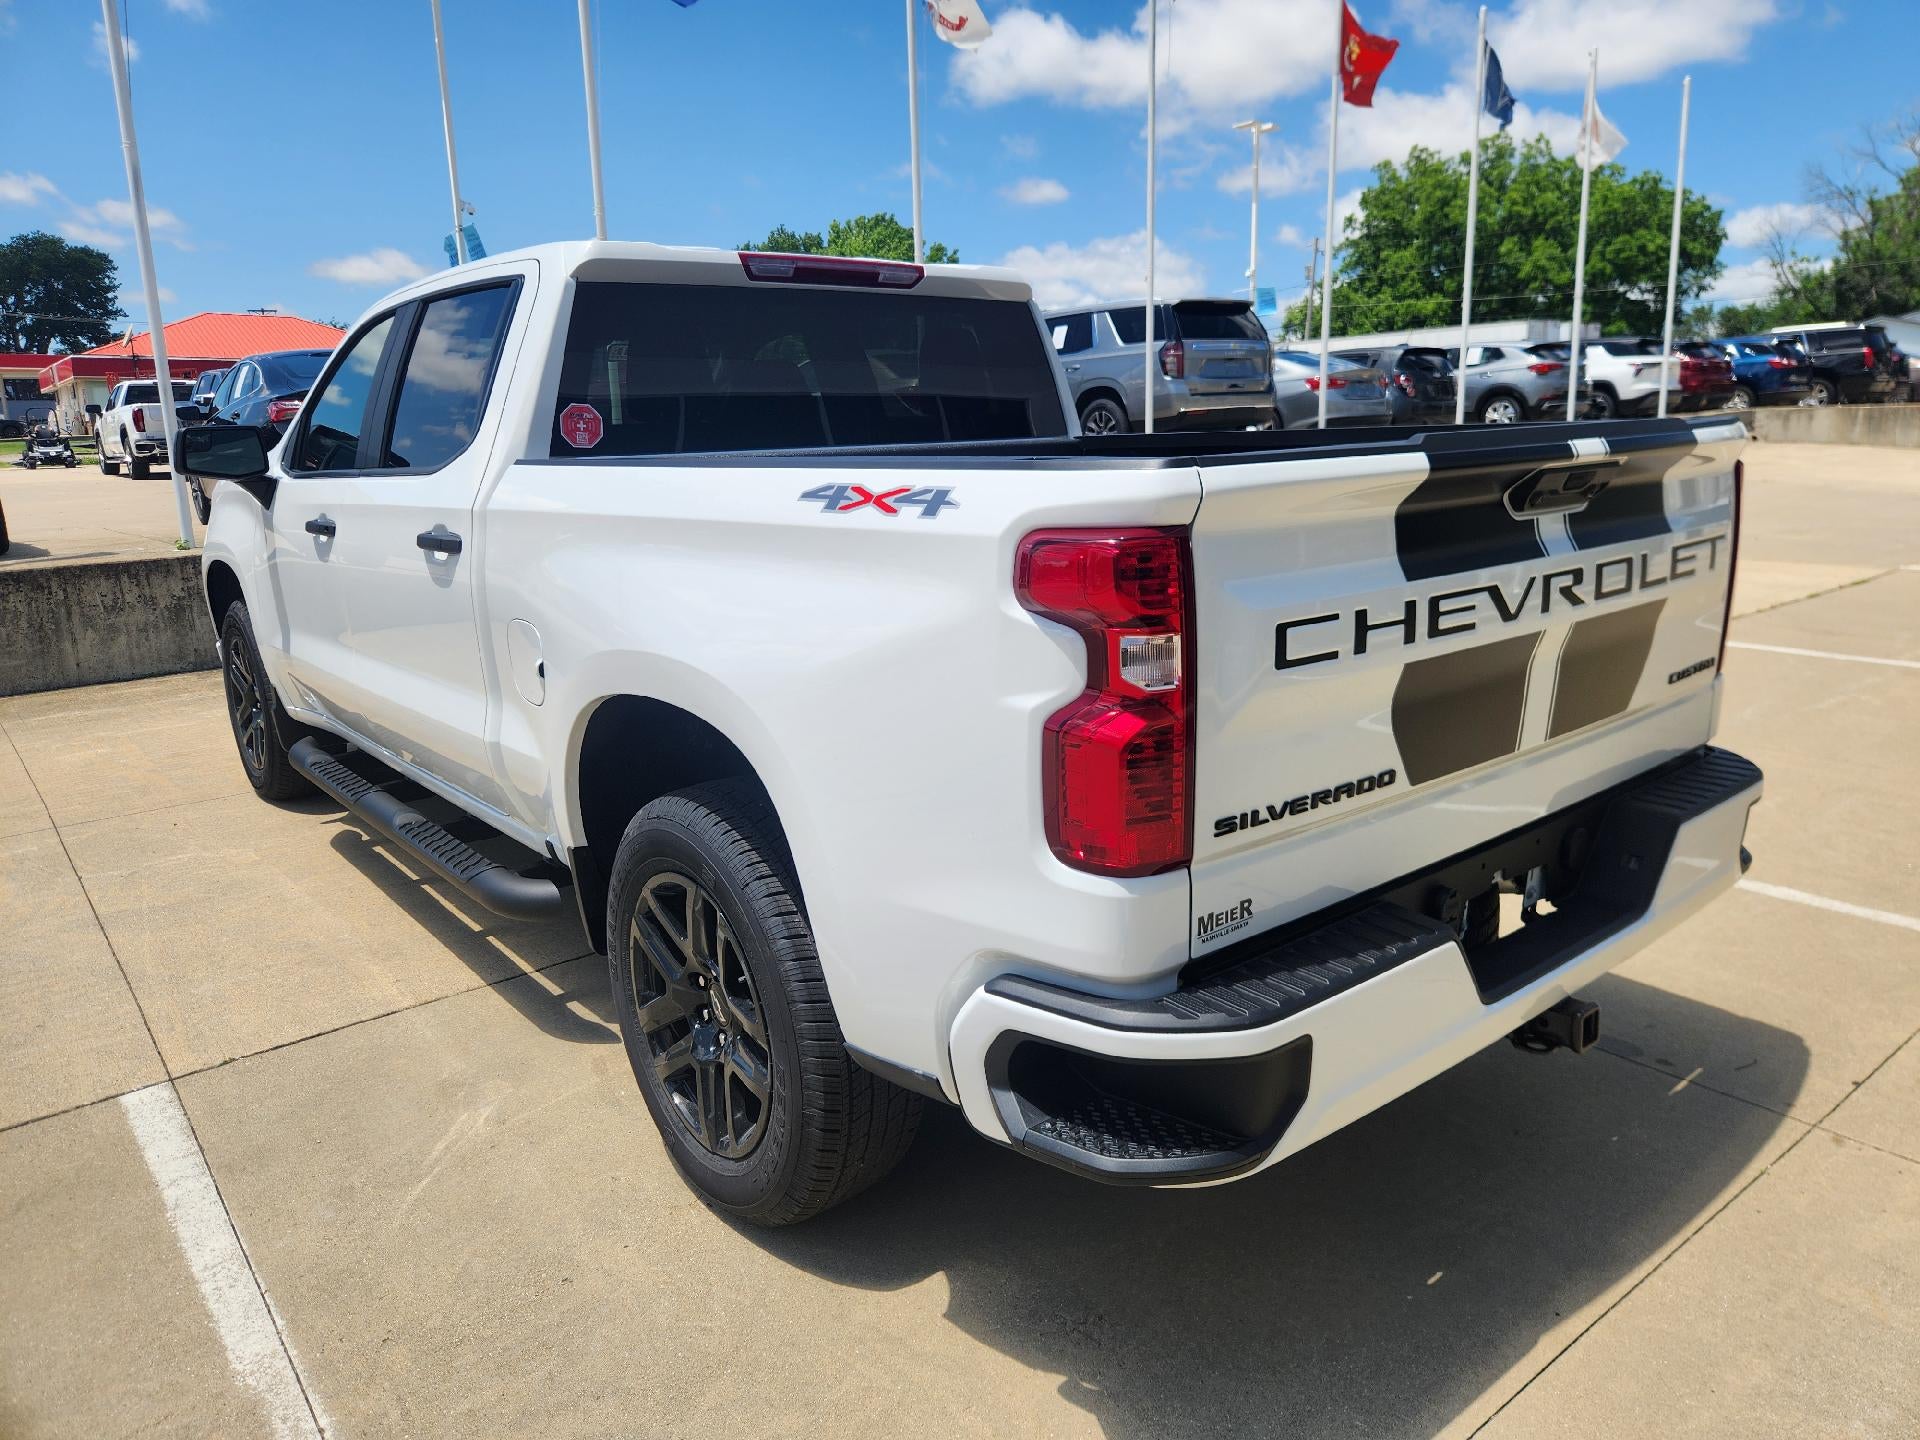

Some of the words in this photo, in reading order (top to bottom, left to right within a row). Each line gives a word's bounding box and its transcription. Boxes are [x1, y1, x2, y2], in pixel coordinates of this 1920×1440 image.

[1274, 534, 1726, 670] CHEVROLET
[1213, 768, 1396, 838] SILVERADO
[1197, 898, 1253, 937] MEIER
